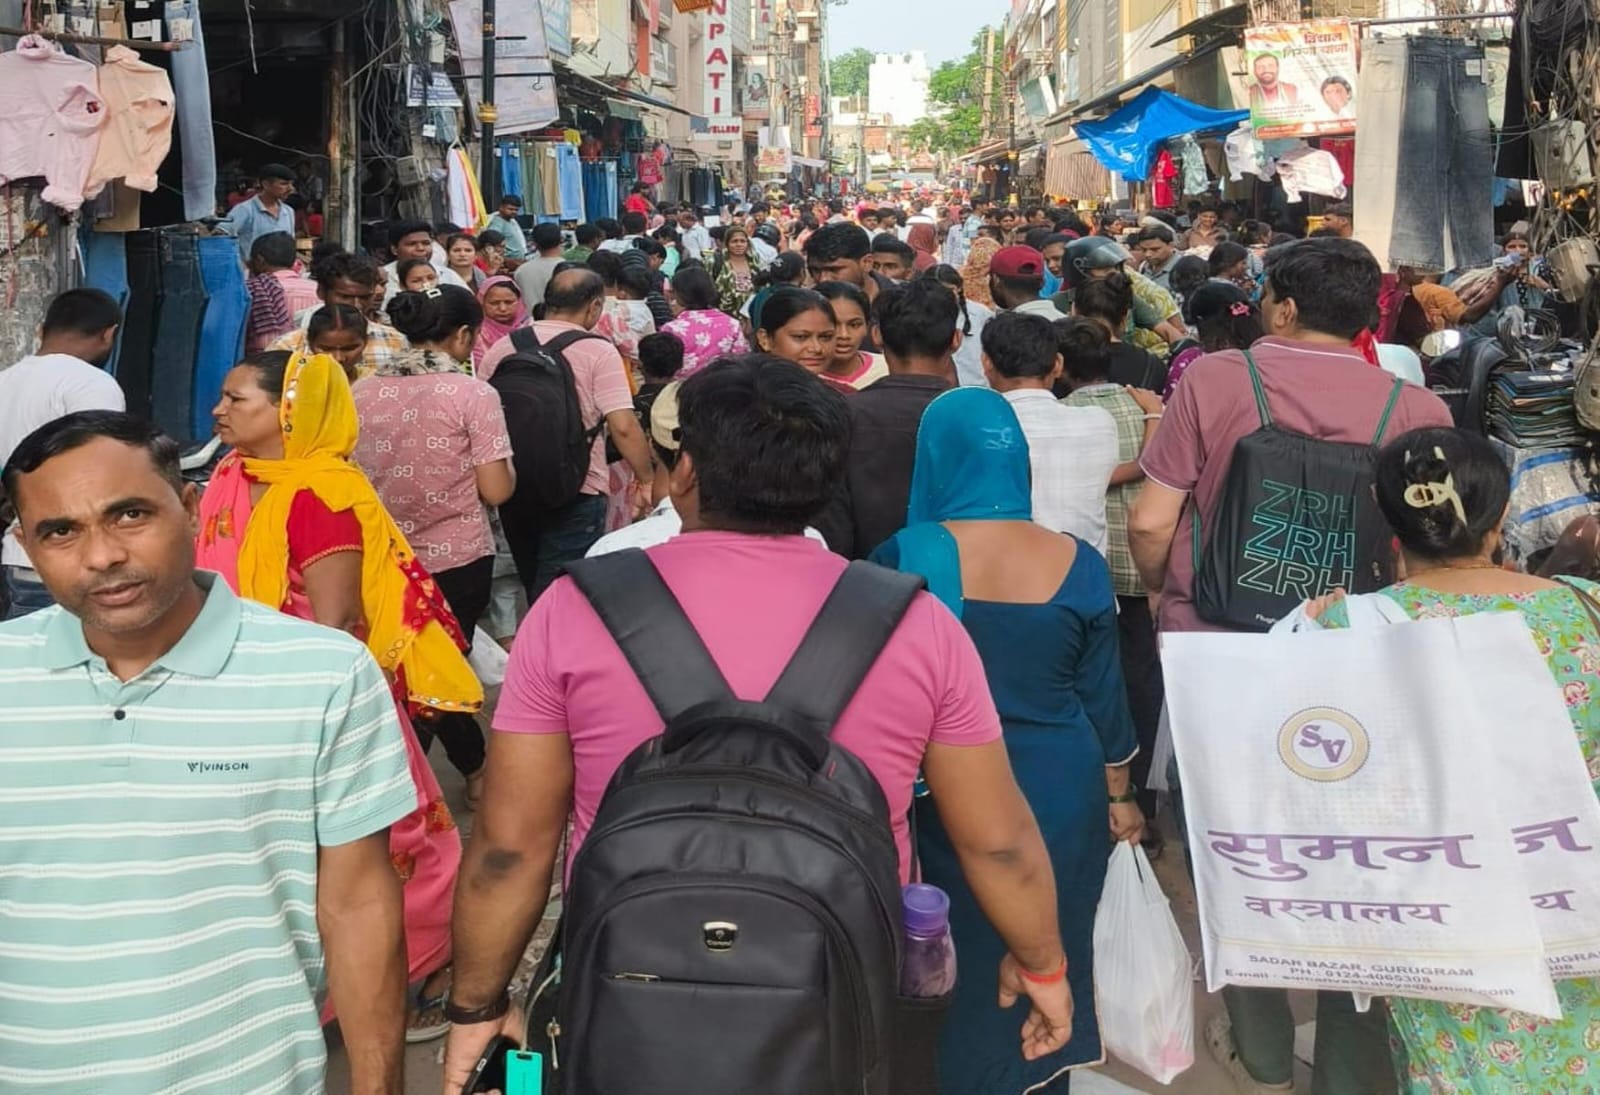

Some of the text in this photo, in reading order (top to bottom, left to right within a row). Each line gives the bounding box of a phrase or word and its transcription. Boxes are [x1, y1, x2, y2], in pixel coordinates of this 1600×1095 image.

[708, 125, 741, 134] ELLERS
[1254, 479, 1356, 531] ZRH
[1245, 514, 1356, 569] ZRH
[1237, 550, 1353, 600] ZRH
[1299, 724, 1346, 763] SV
[204, 762, 249, 771] VINSON
[1208, 830, 1481, 882] सुमन
[1243, 895, 1451, 925] वस्त्रालय
[1249, 954, 1474, 976] SADAR BAZAR, GURUGRAM
